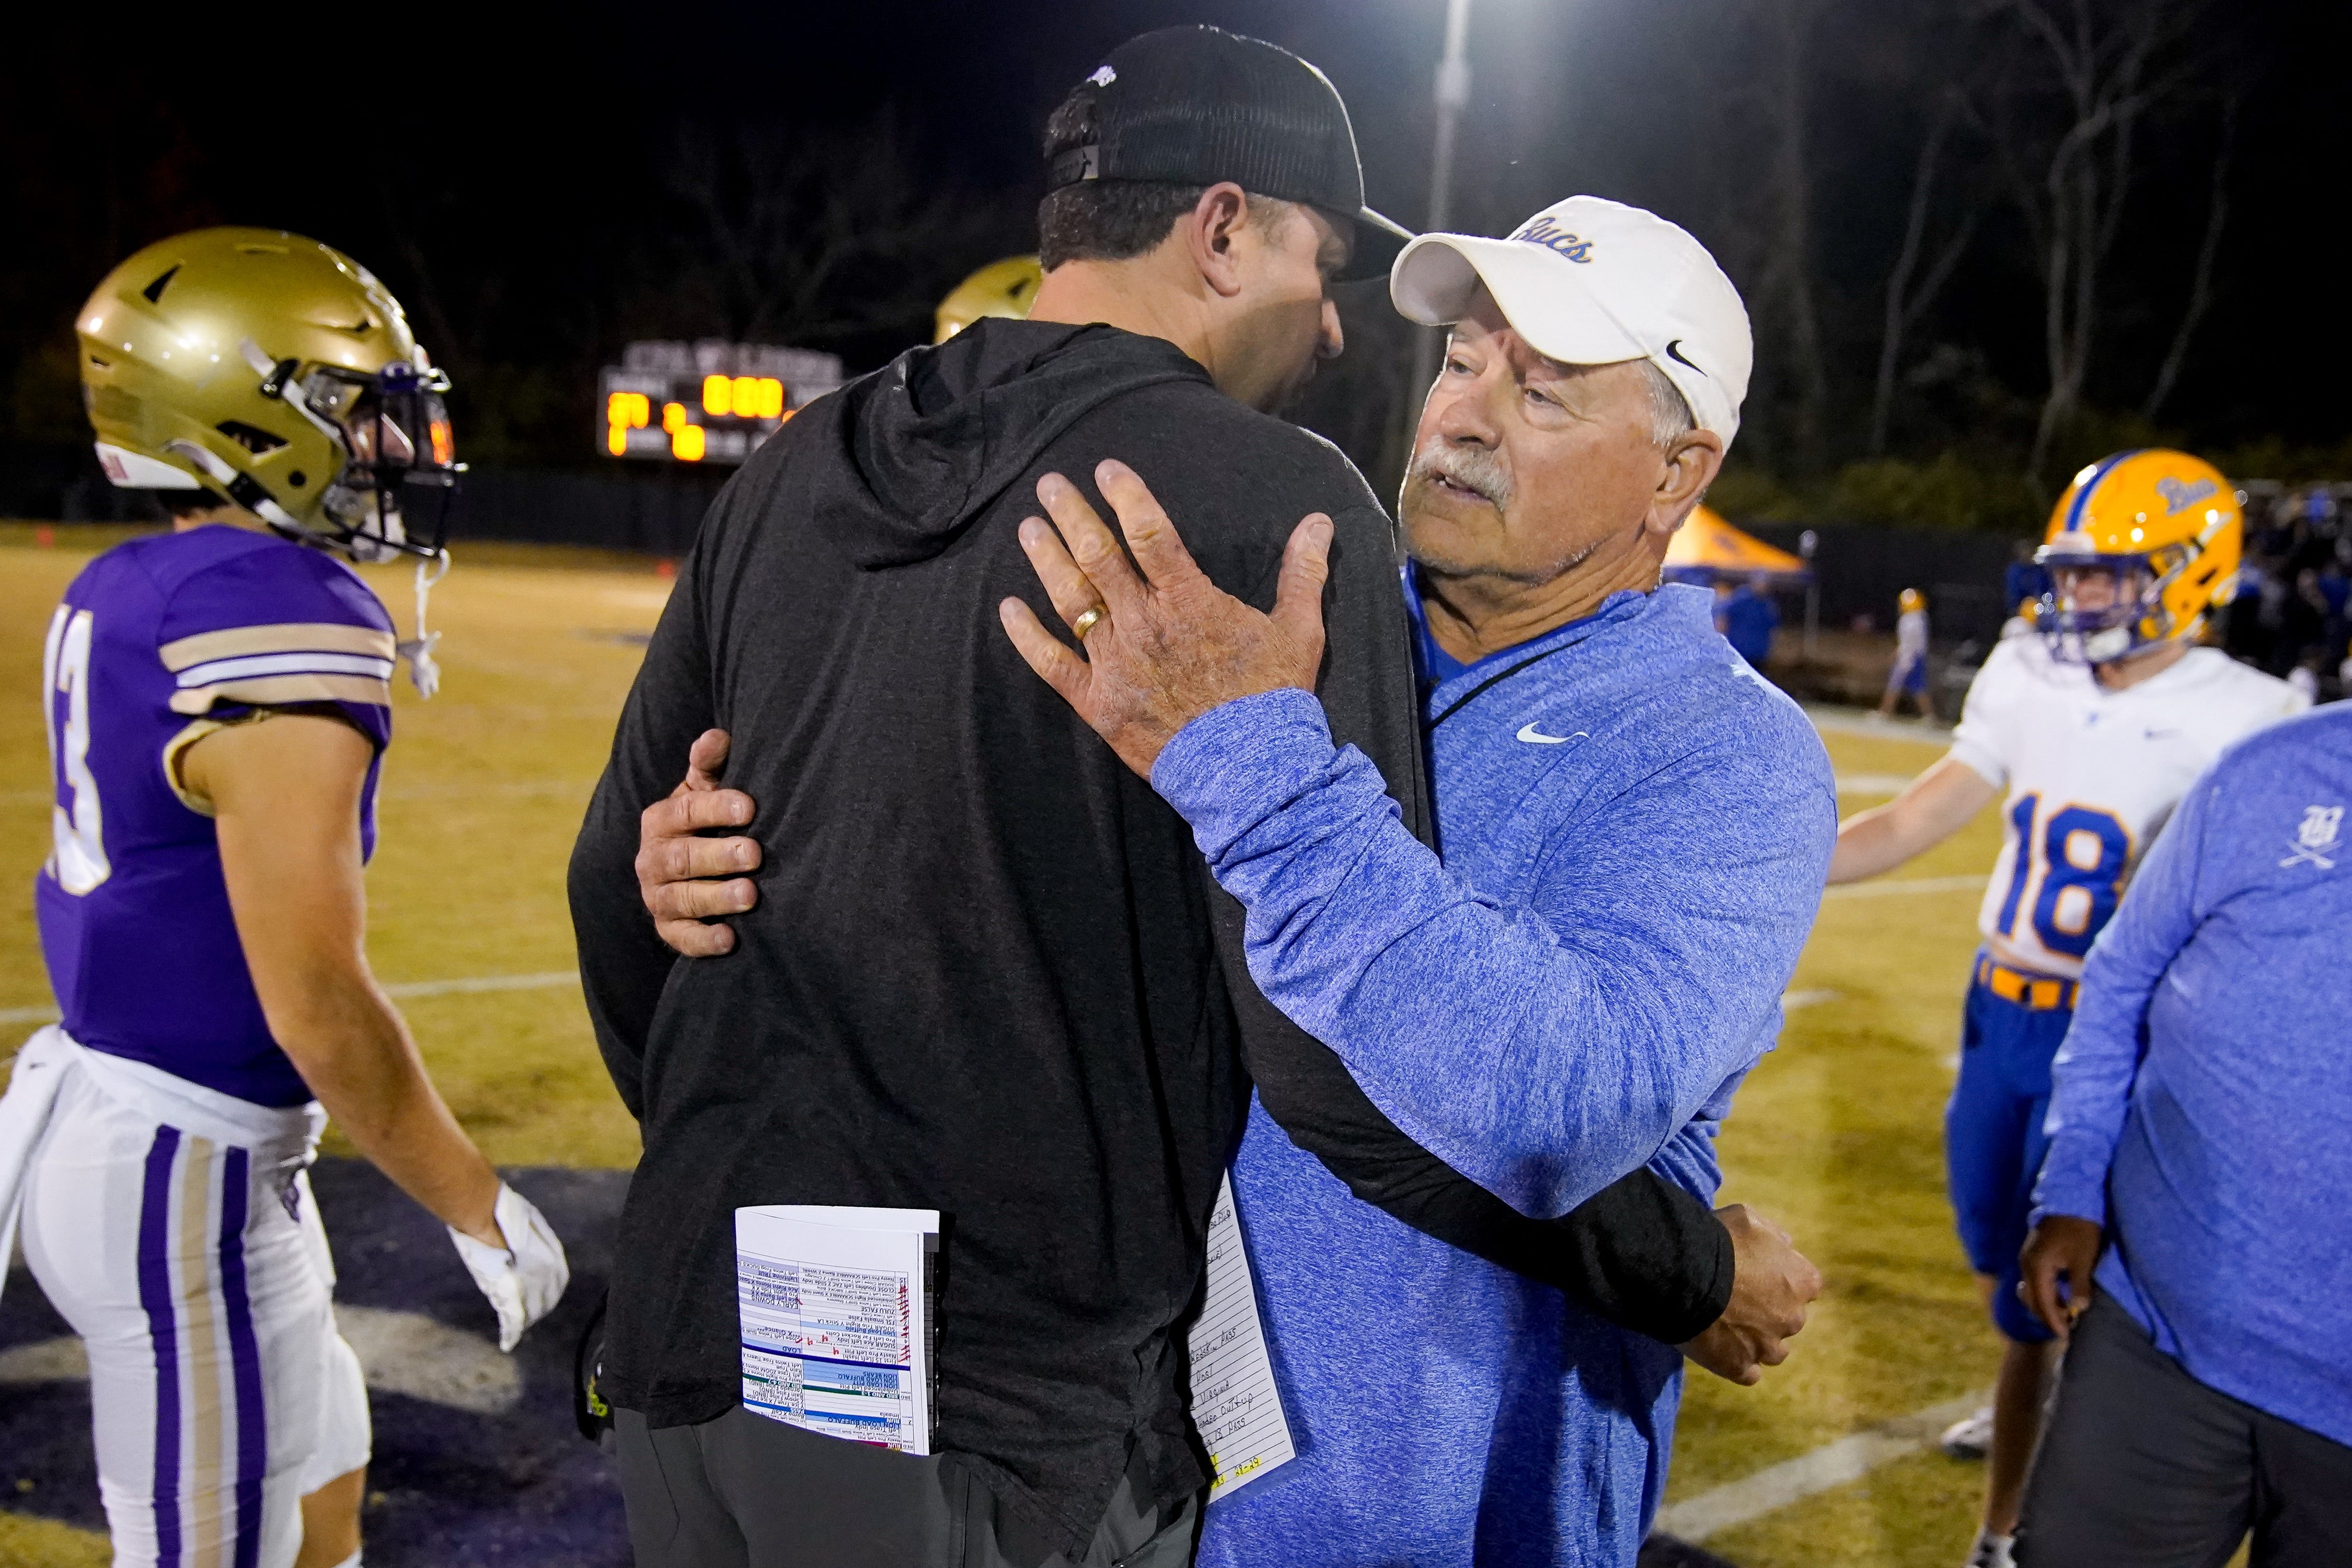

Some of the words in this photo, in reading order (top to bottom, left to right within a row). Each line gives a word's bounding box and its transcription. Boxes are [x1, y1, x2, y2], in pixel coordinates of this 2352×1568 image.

[1995, 791, 2136, 963] 18
[777, 1300, 799, 1309] EARLY
[828, 1417, 859, 1425] BUFFALO
